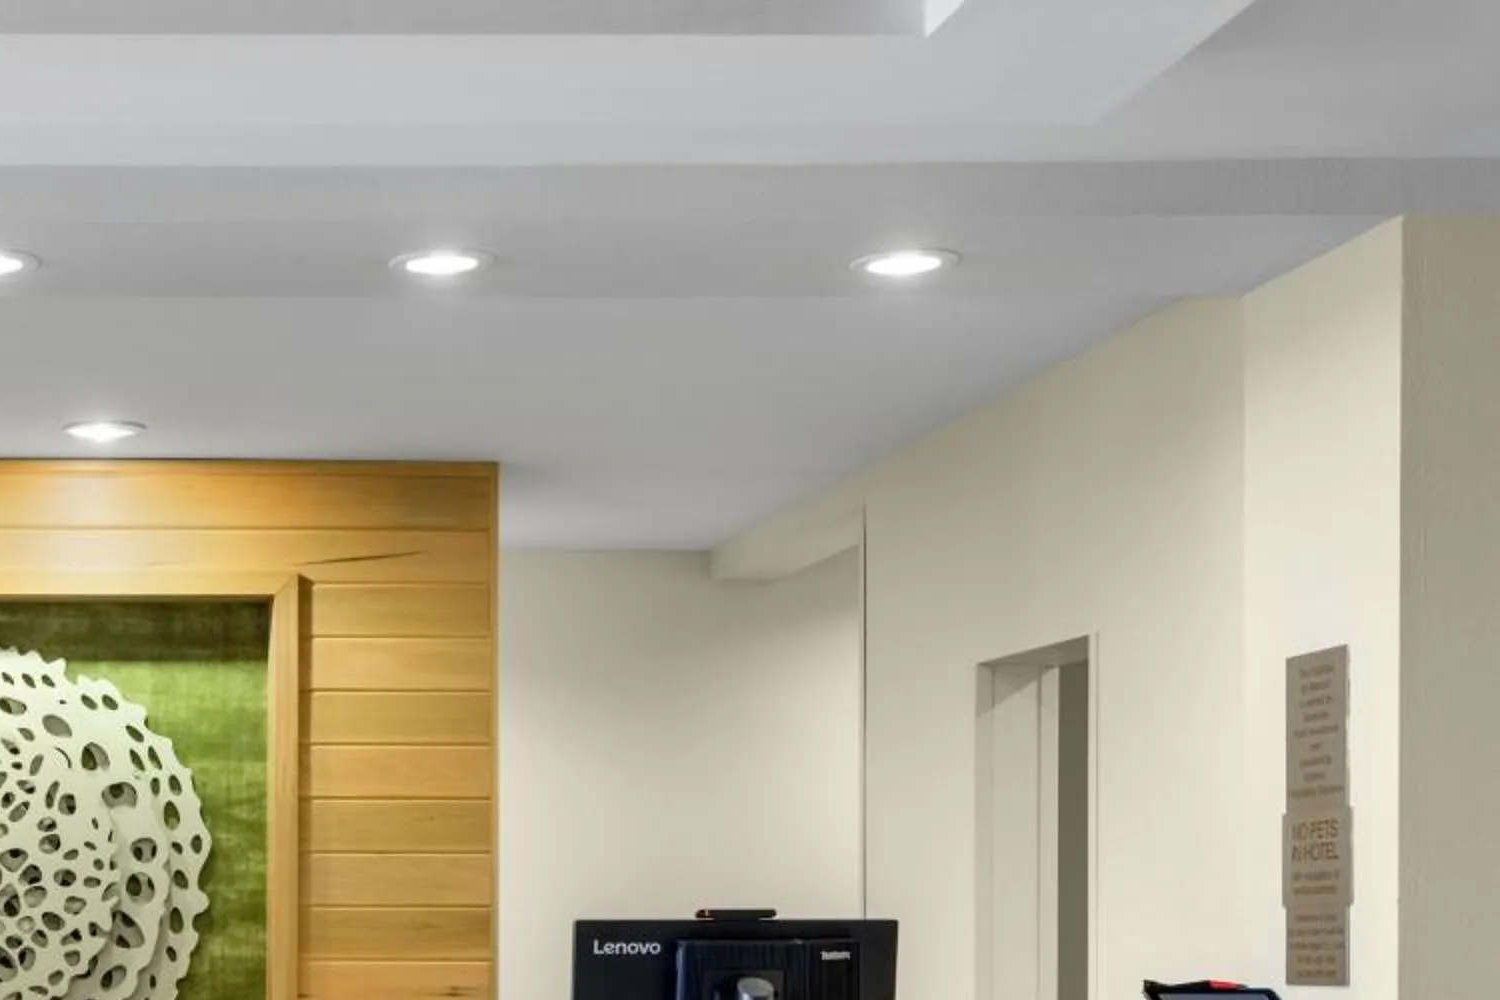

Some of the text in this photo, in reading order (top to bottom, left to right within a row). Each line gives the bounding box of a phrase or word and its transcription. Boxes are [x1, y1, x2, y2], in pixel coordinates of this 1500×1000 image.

[1310, 818, 1339, 840] PETS
[1303, 841, 1340, 862] HOTEL
[593, 938, 661, 955] Lenovo
